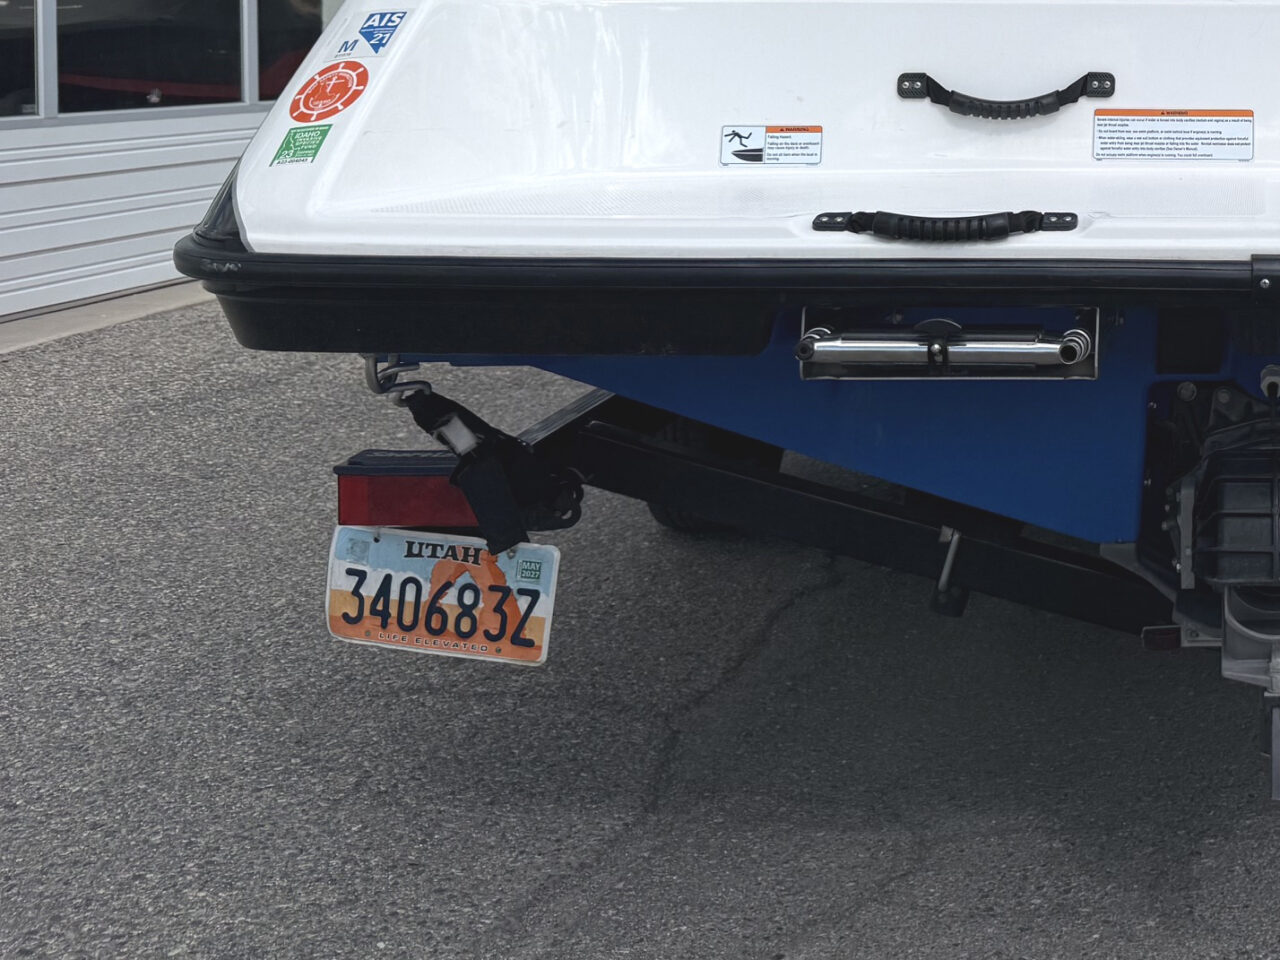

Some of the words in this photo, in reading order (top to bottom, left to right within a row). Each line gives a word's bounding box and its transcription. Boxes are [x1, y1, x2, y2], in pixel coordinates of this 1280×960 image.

[363, 12, 404, 28] AIS
[369, 33, 391, 45] 21
[337, 39, 360, 53] M
[294, 131, 321, 139] IDAHO
[280, 150, 294, 159] 23
[404, 540, 483, 566] UTAH
[522, 561, 541, 571] MAY
[521, 569, 541, 579] 2027
[341, 567, 541, 648] 340683Z
[379, 632, 407, 642] LIFE
[415, 637, 489, 653] ELEVATED
